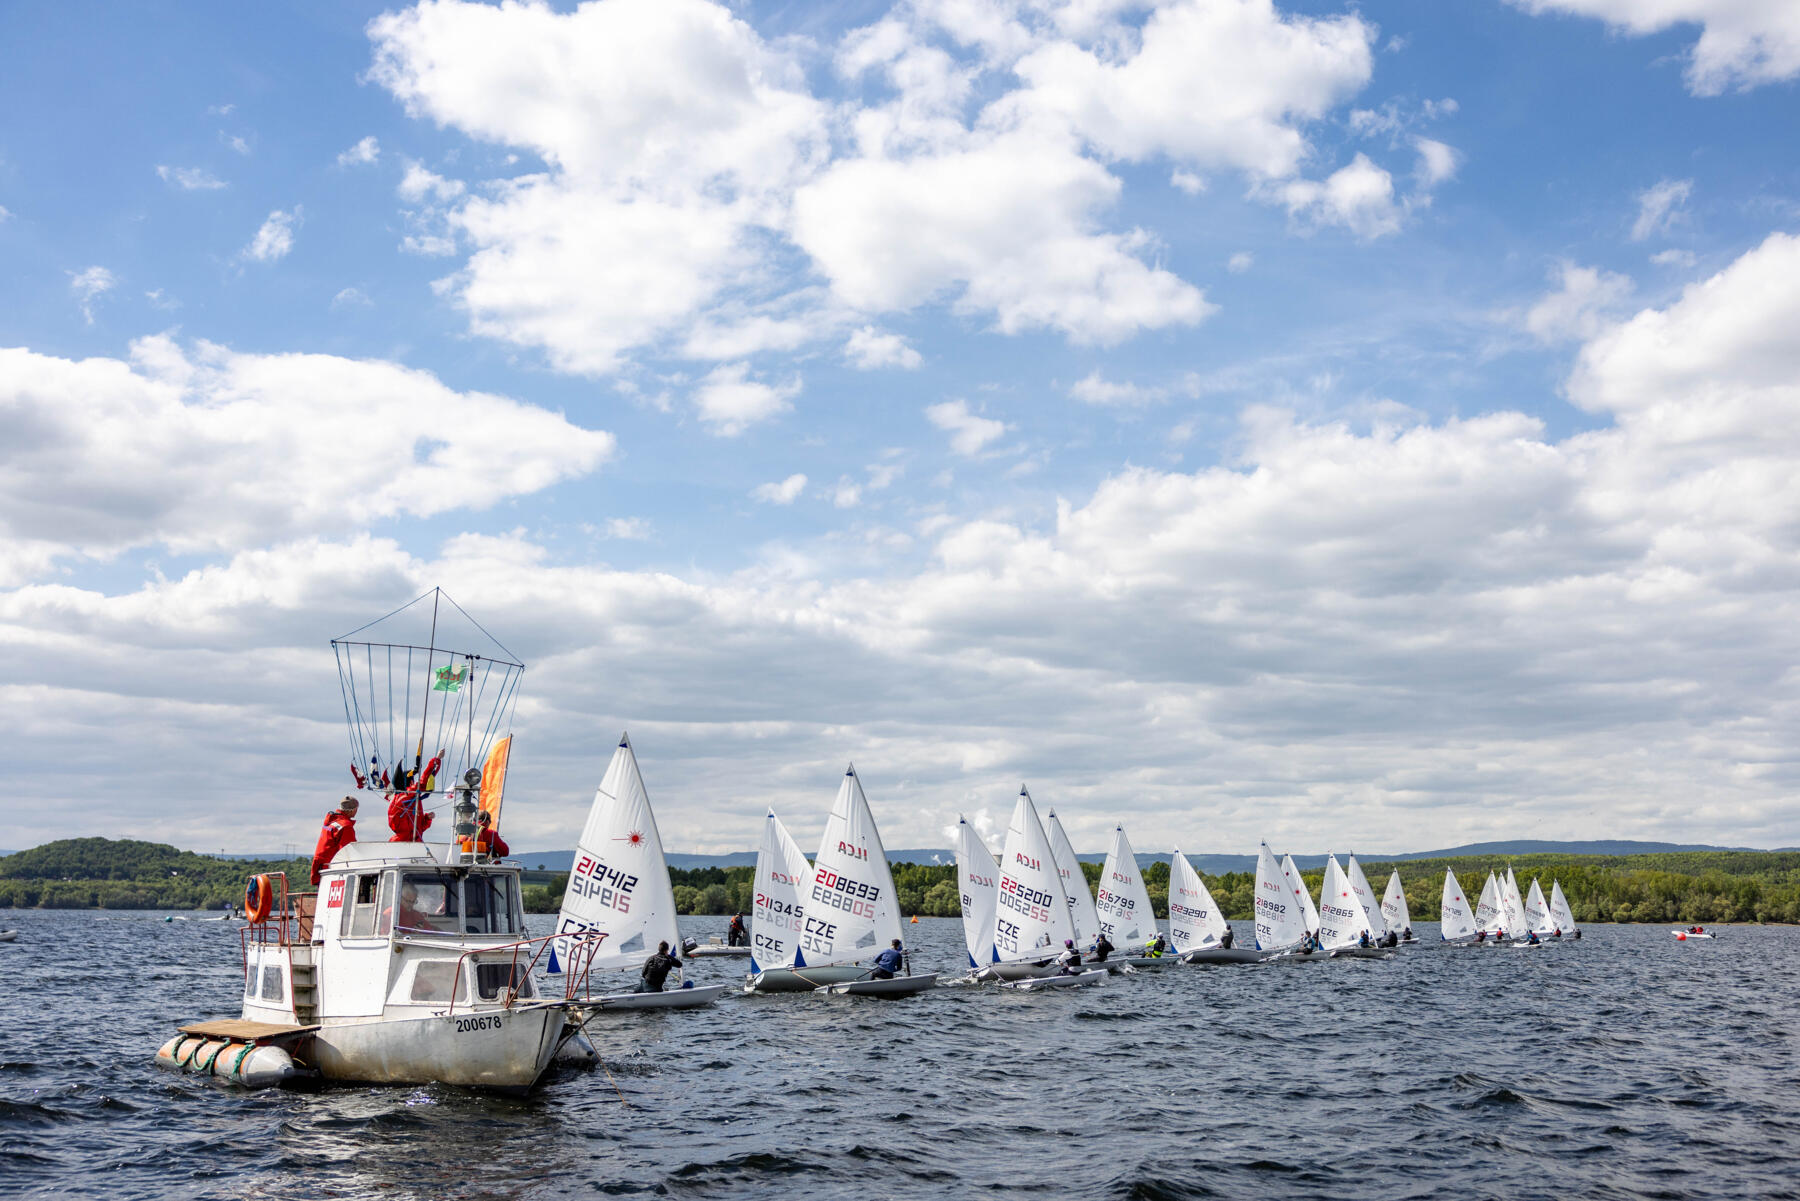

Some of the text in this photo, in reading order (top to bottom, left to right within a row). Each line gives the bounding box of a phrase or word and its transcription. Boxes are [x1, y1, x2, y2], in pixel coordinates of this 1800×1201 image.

[576, 855, 639, 893] 219412
[815, 868, 880, 901] 208693
[1001, 876, 1052, 908] 225200
[756, 893, 804, 918] 211345
[1099, 889, 1135, 910] 216799
[1256, 896, 1286, 914] 218982
[1171, 903, 1207, 919] 223290
[1322, 903, 1354, 918] 212865
[805, 917, 837, 940] CZE
[997, 918, 1020, 939] CZE
[1099, 920, 1115, 935] ZE
[1172, 928, 1190, 940] CZE
[1256, 923, 1272, 936] CZE
[1320, 927, 1338, 938] CZE
[755, 933, 784, 953] CZE
[455, 1015, 502, 1033] 200678
